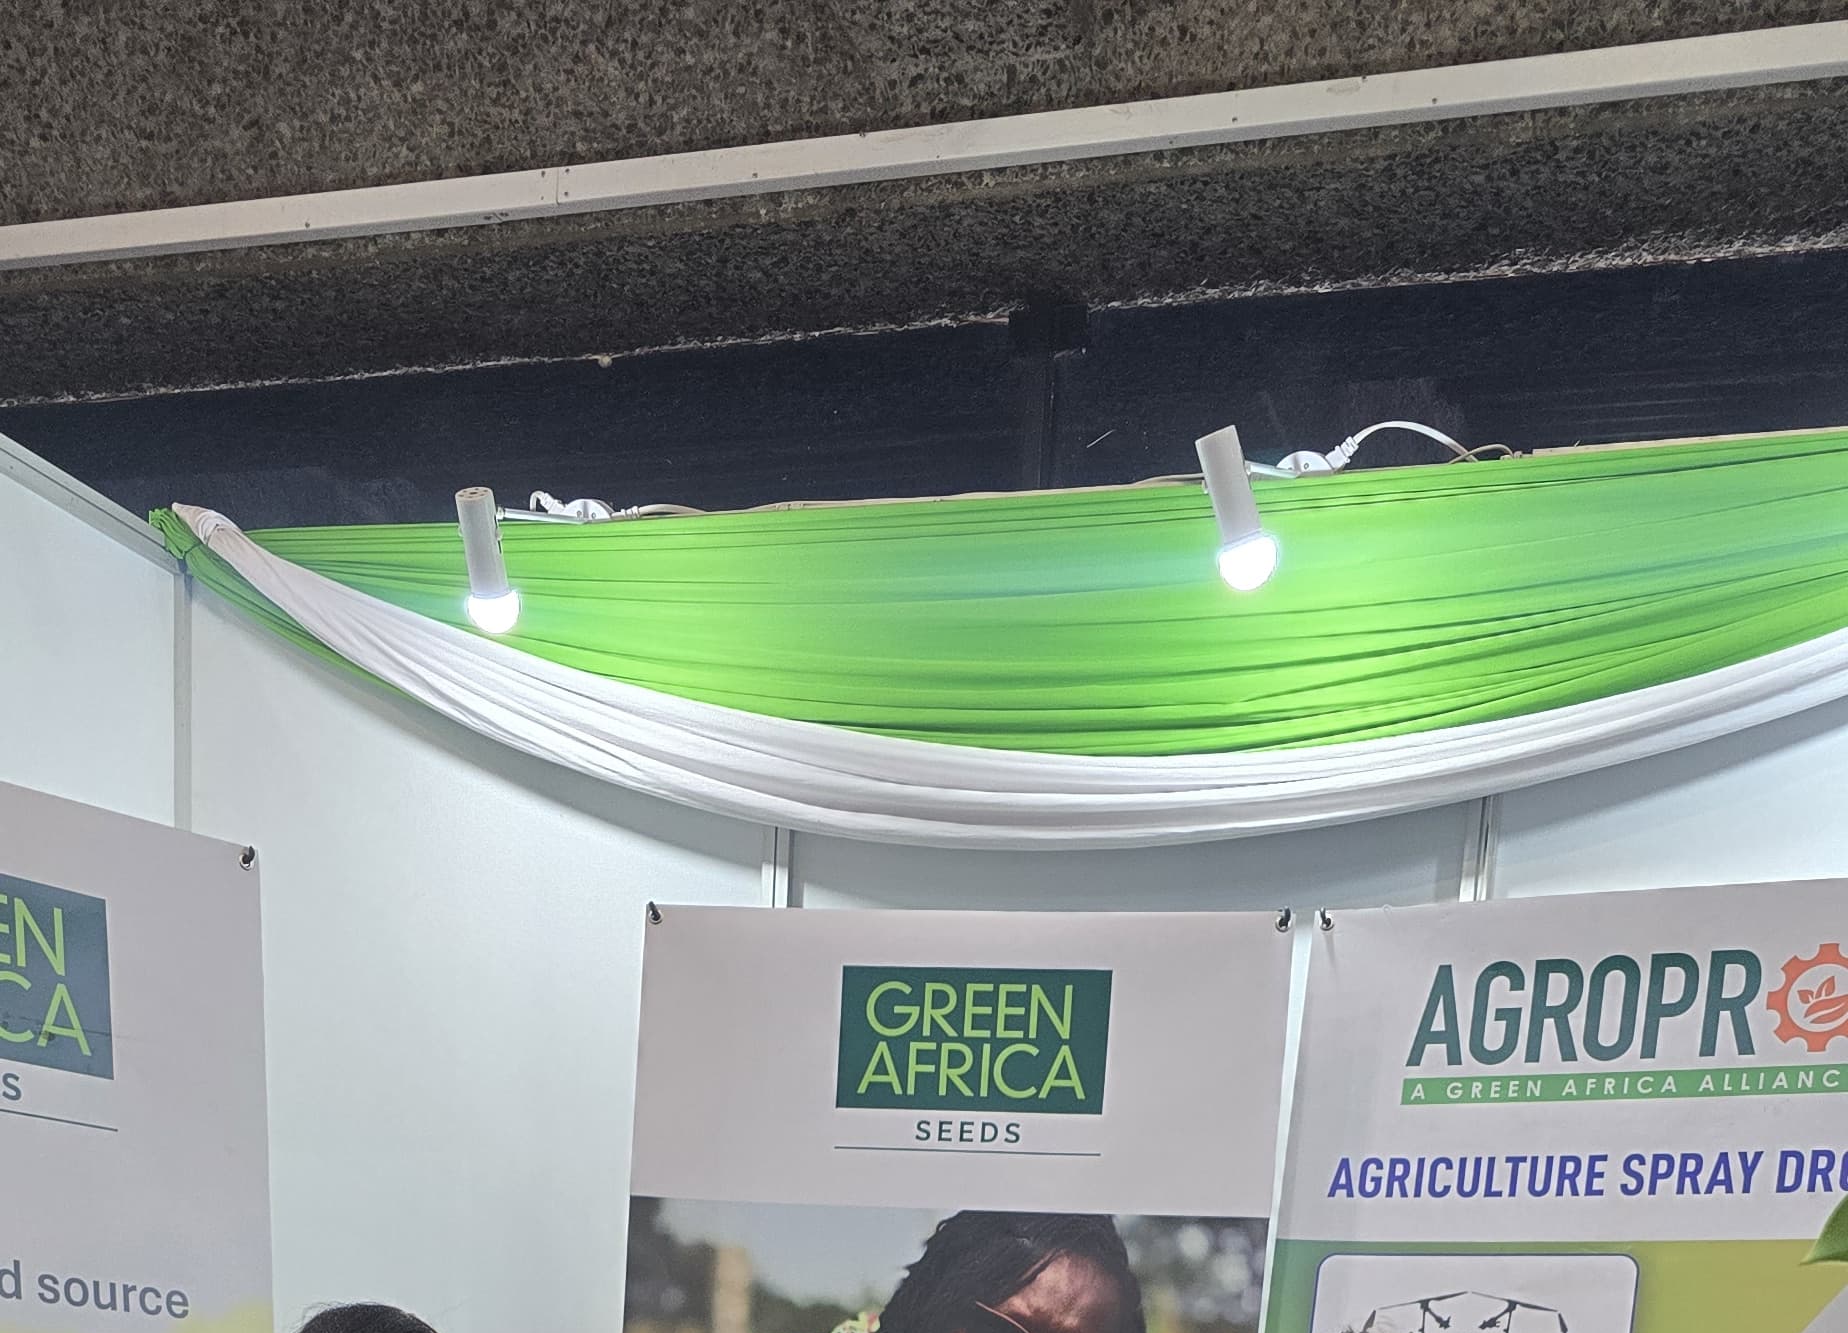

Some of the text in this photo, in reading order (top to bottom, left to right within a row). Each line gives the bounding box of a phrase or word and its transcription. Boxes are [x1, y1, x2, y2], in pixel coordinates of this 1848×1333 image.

[866, 981, 1073, 1039] GREEN
[857, 1041, 1085, 1100] AFRICA
[1411, 1083, 1425, 1100] A
[1447, 1080, 1542, 1101] GREEN
[1563, 1074, 1677, 1097] AFRICA
[915, 1120, 1021, 1144] SEEDS
[1328, 1154, 1608, 1198] AGRICULTURE
[1620, 1151, 1764, 1196] SPRAY
[37, 1273, 189, 1319] source
